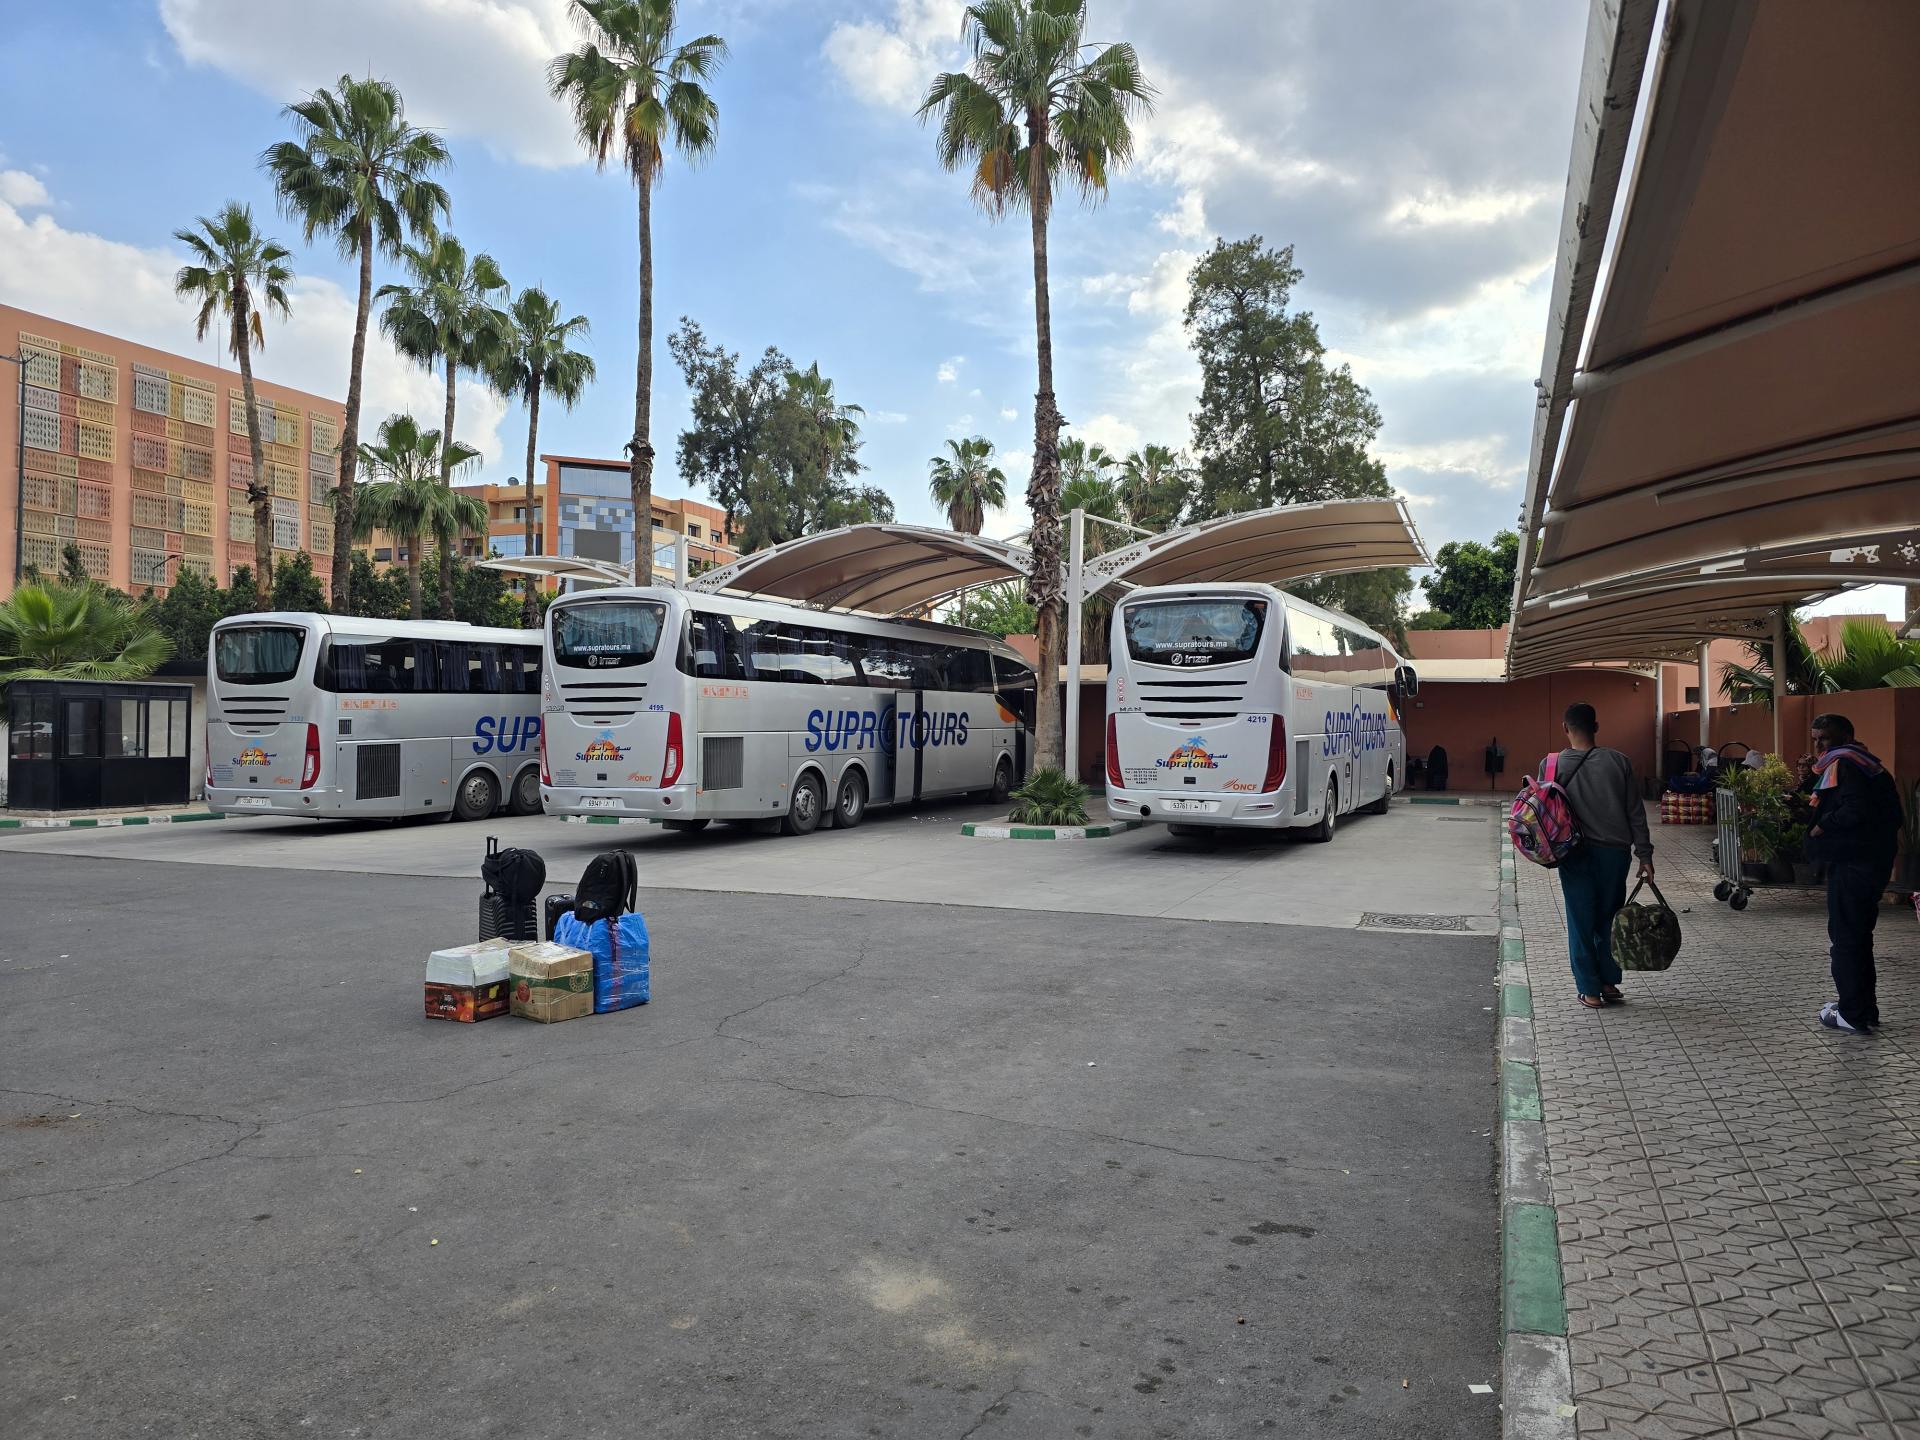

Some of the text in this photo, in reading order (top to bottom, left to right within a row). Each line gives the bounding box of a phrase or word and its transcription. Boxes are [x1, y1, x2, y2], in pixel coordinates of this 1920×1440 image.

[573, 644, 631, 653] www.supratours.ma
[1154, 641, 1229, 650] www.supratours.ma
[232, 757, 271, 767] Supratours
[575, 752, 624, 763] Supratours
[1155, 758, 1219, 770] Supratours
[1232, 783, 1257, 791] ONCF
